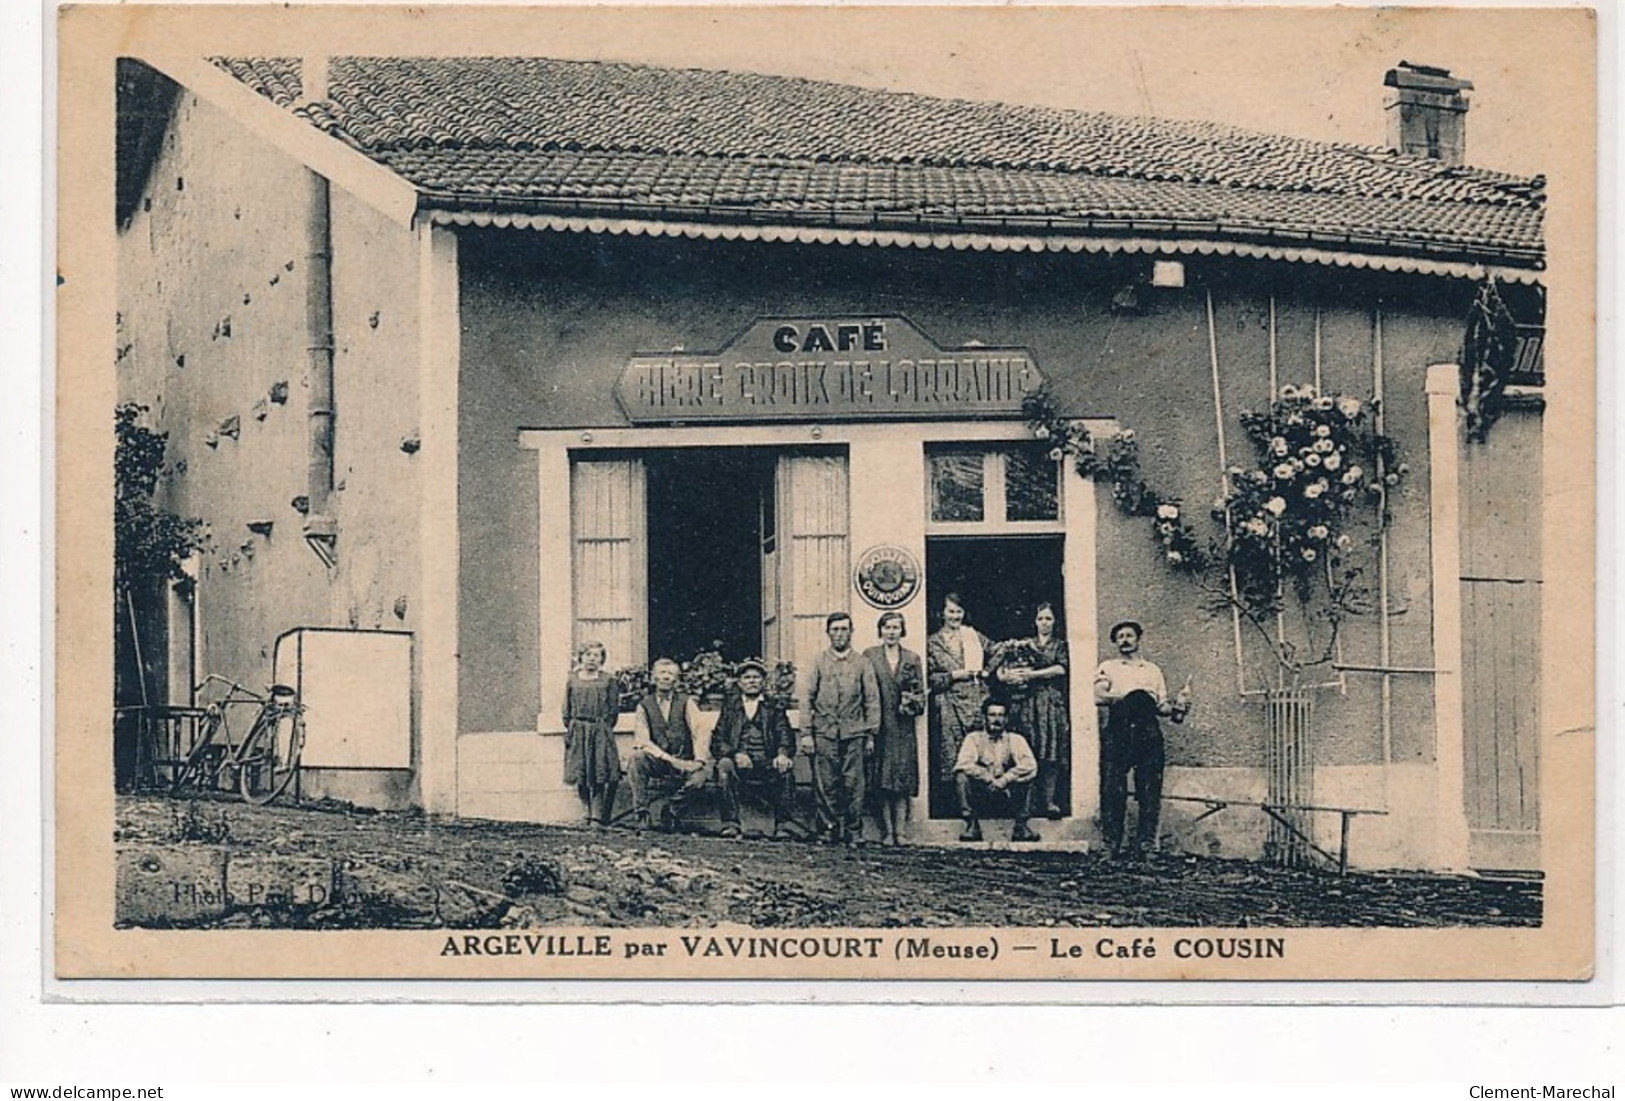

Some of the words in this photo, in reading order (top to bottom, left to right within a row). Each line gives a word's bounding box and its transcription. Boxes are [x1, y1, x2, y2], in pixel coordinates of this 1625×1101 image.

[773, 319, 887, 353] CAFÉ
[734, 361, 830, 405] CROIX
[834, 361, 873, 403] DE
[879, 358, 1029, 402] LORRAINE
